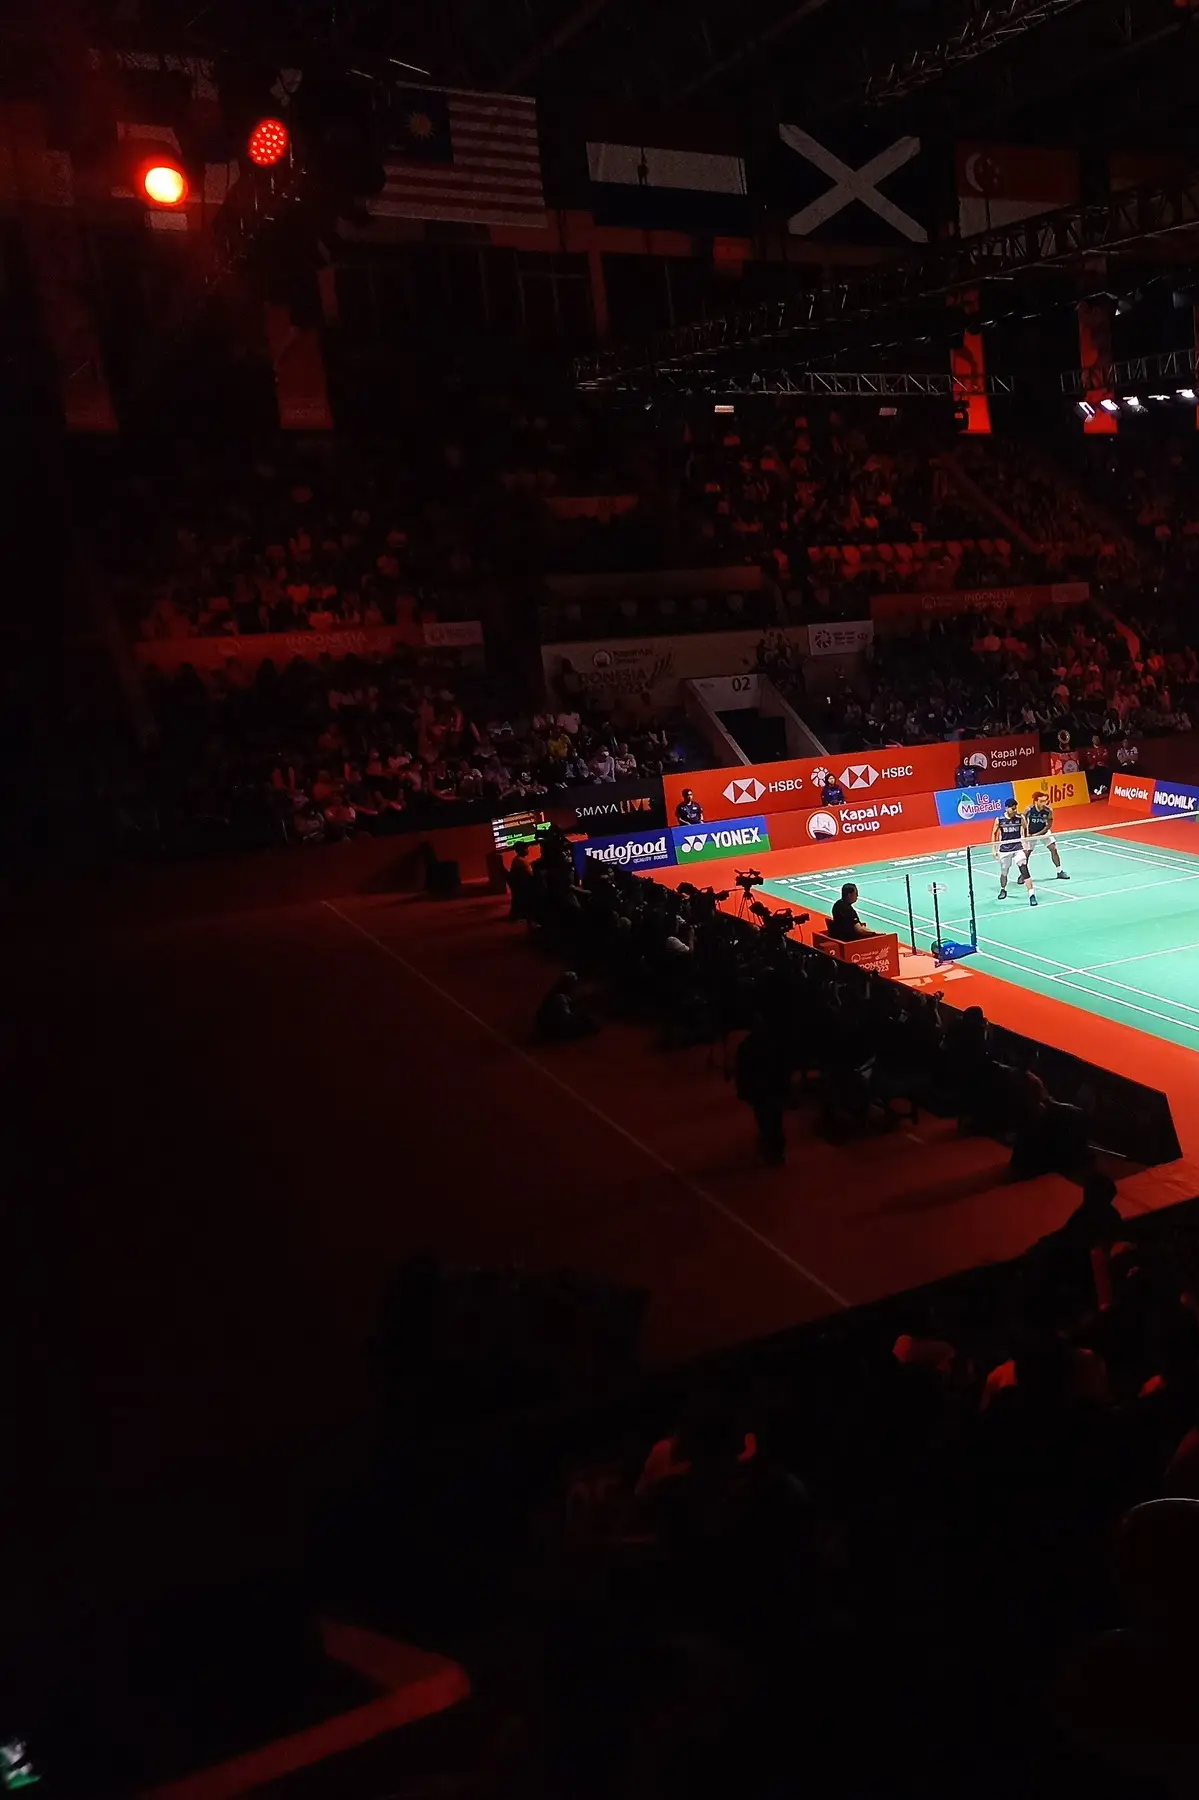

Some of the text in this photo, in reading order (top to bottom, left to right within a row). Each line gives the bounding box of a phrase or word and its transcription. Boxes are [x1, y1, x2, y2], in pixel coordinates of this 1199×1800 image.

[732, 678, 750, 692] 02
[991, 746, 1035, 760] Kapal Api
[992, 759, 1018, 768] Group
[881, 766, 913, 779] HSBC
[769, 779, 803, 793] HSBC
[1114, 785, 1149, 801] MakCiak
[977, 792, 989, 804] Le
[1154, 791, 1197, 810] INDOMILK
[840, 801, 903, 821] Kapal Api
[842, 820, 880, 834] Group
[711, 827, 761, 848] YONEX
[585, 837, 667, 865] Indofood
